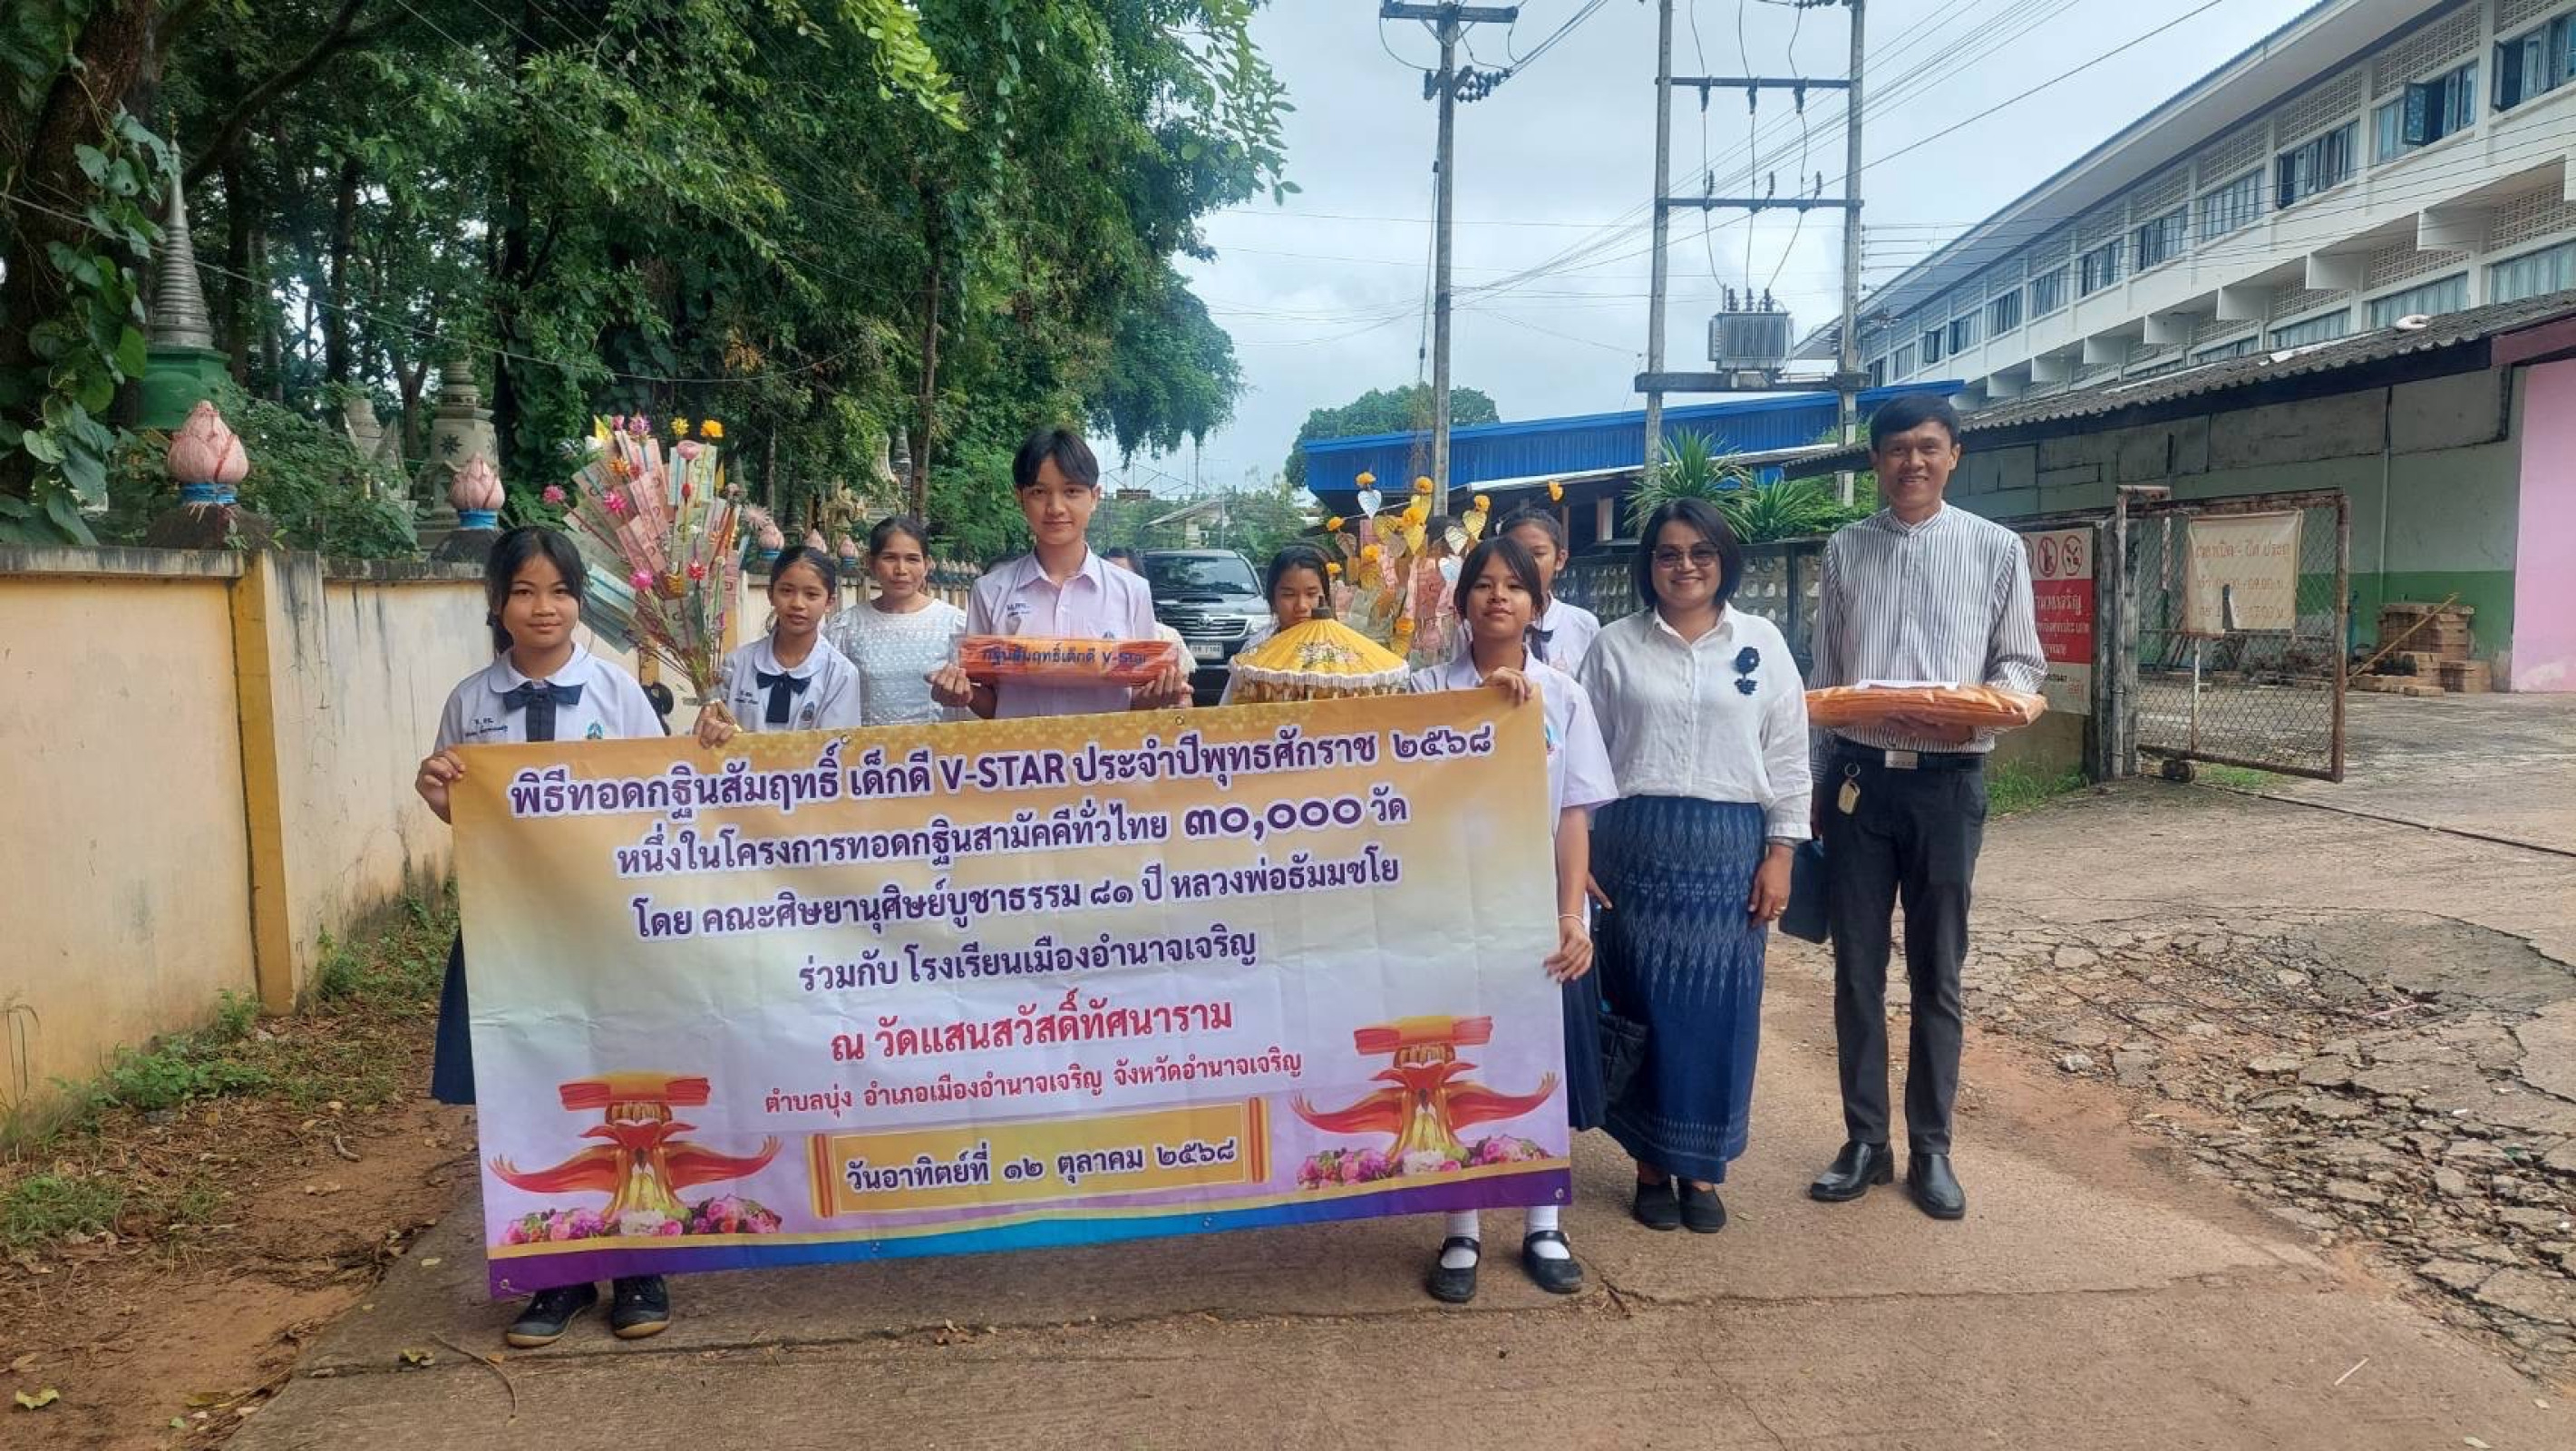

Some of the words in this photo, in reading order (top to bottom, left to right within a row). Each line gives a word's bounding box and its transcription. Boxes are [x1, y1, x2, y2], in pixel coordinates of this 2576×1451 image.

[510, 743, 840, 820] พิธีทอดกฐินสัมฤทธิ์
[850, 749, 931, 796] เด็กดี
[939, 753, 1067, 790] V-STAR
[1072, 729, 1376, 787] ประจำปีพุทธศักราช
[1392, 725, 1492, 758] ๒๕๖๘
[617, 800, 1168, 874] หนึ่งในโครงการทอดกฐินสามัคคีทั่วไทย
[1185, 799, 1363, 842] ๓๐,๐๐๐
[1370, 785, 1408, 823] วัด
[632, 897, 693, 938] โดย
[704, 878, 1081, 935] คณะศิษยานุศิษย์บูชาธรรม
[1089, 880, 1135, 906] ๘๑
[1141, 862, 1163, 902] ปี
[1170, 845, 1399, 899] หลวงพ่อธัมมชโย
[800, 949, 899, 991] ร่วมกับ
[904, 923, 1257, 982] โรงเรียนเมืองอำนาจเจริญ
[831, 1034, 866, 1061] ณ
[880, 988, 1233, 1057] วัดแสนสวัสดิ์ทัศนาราม
[765, 1088, 853, 1118] ตำบลบุ่ง
[864, 1064, 1103, 1106] อำเภอเมืองอำนาจเจริญ
[1113, 1048, 1301, 1086] จังหวัดอำนาจเจริญ
[845, 1142, 990, 1192] วันอาทิตย์ที่
[1003, 1158, 1045, 1181] ๑๒
[1057, 1148, 1144, 1184] ตุลาคม
[1156, 1139, 1236, 1167] ๒๕๖๘
